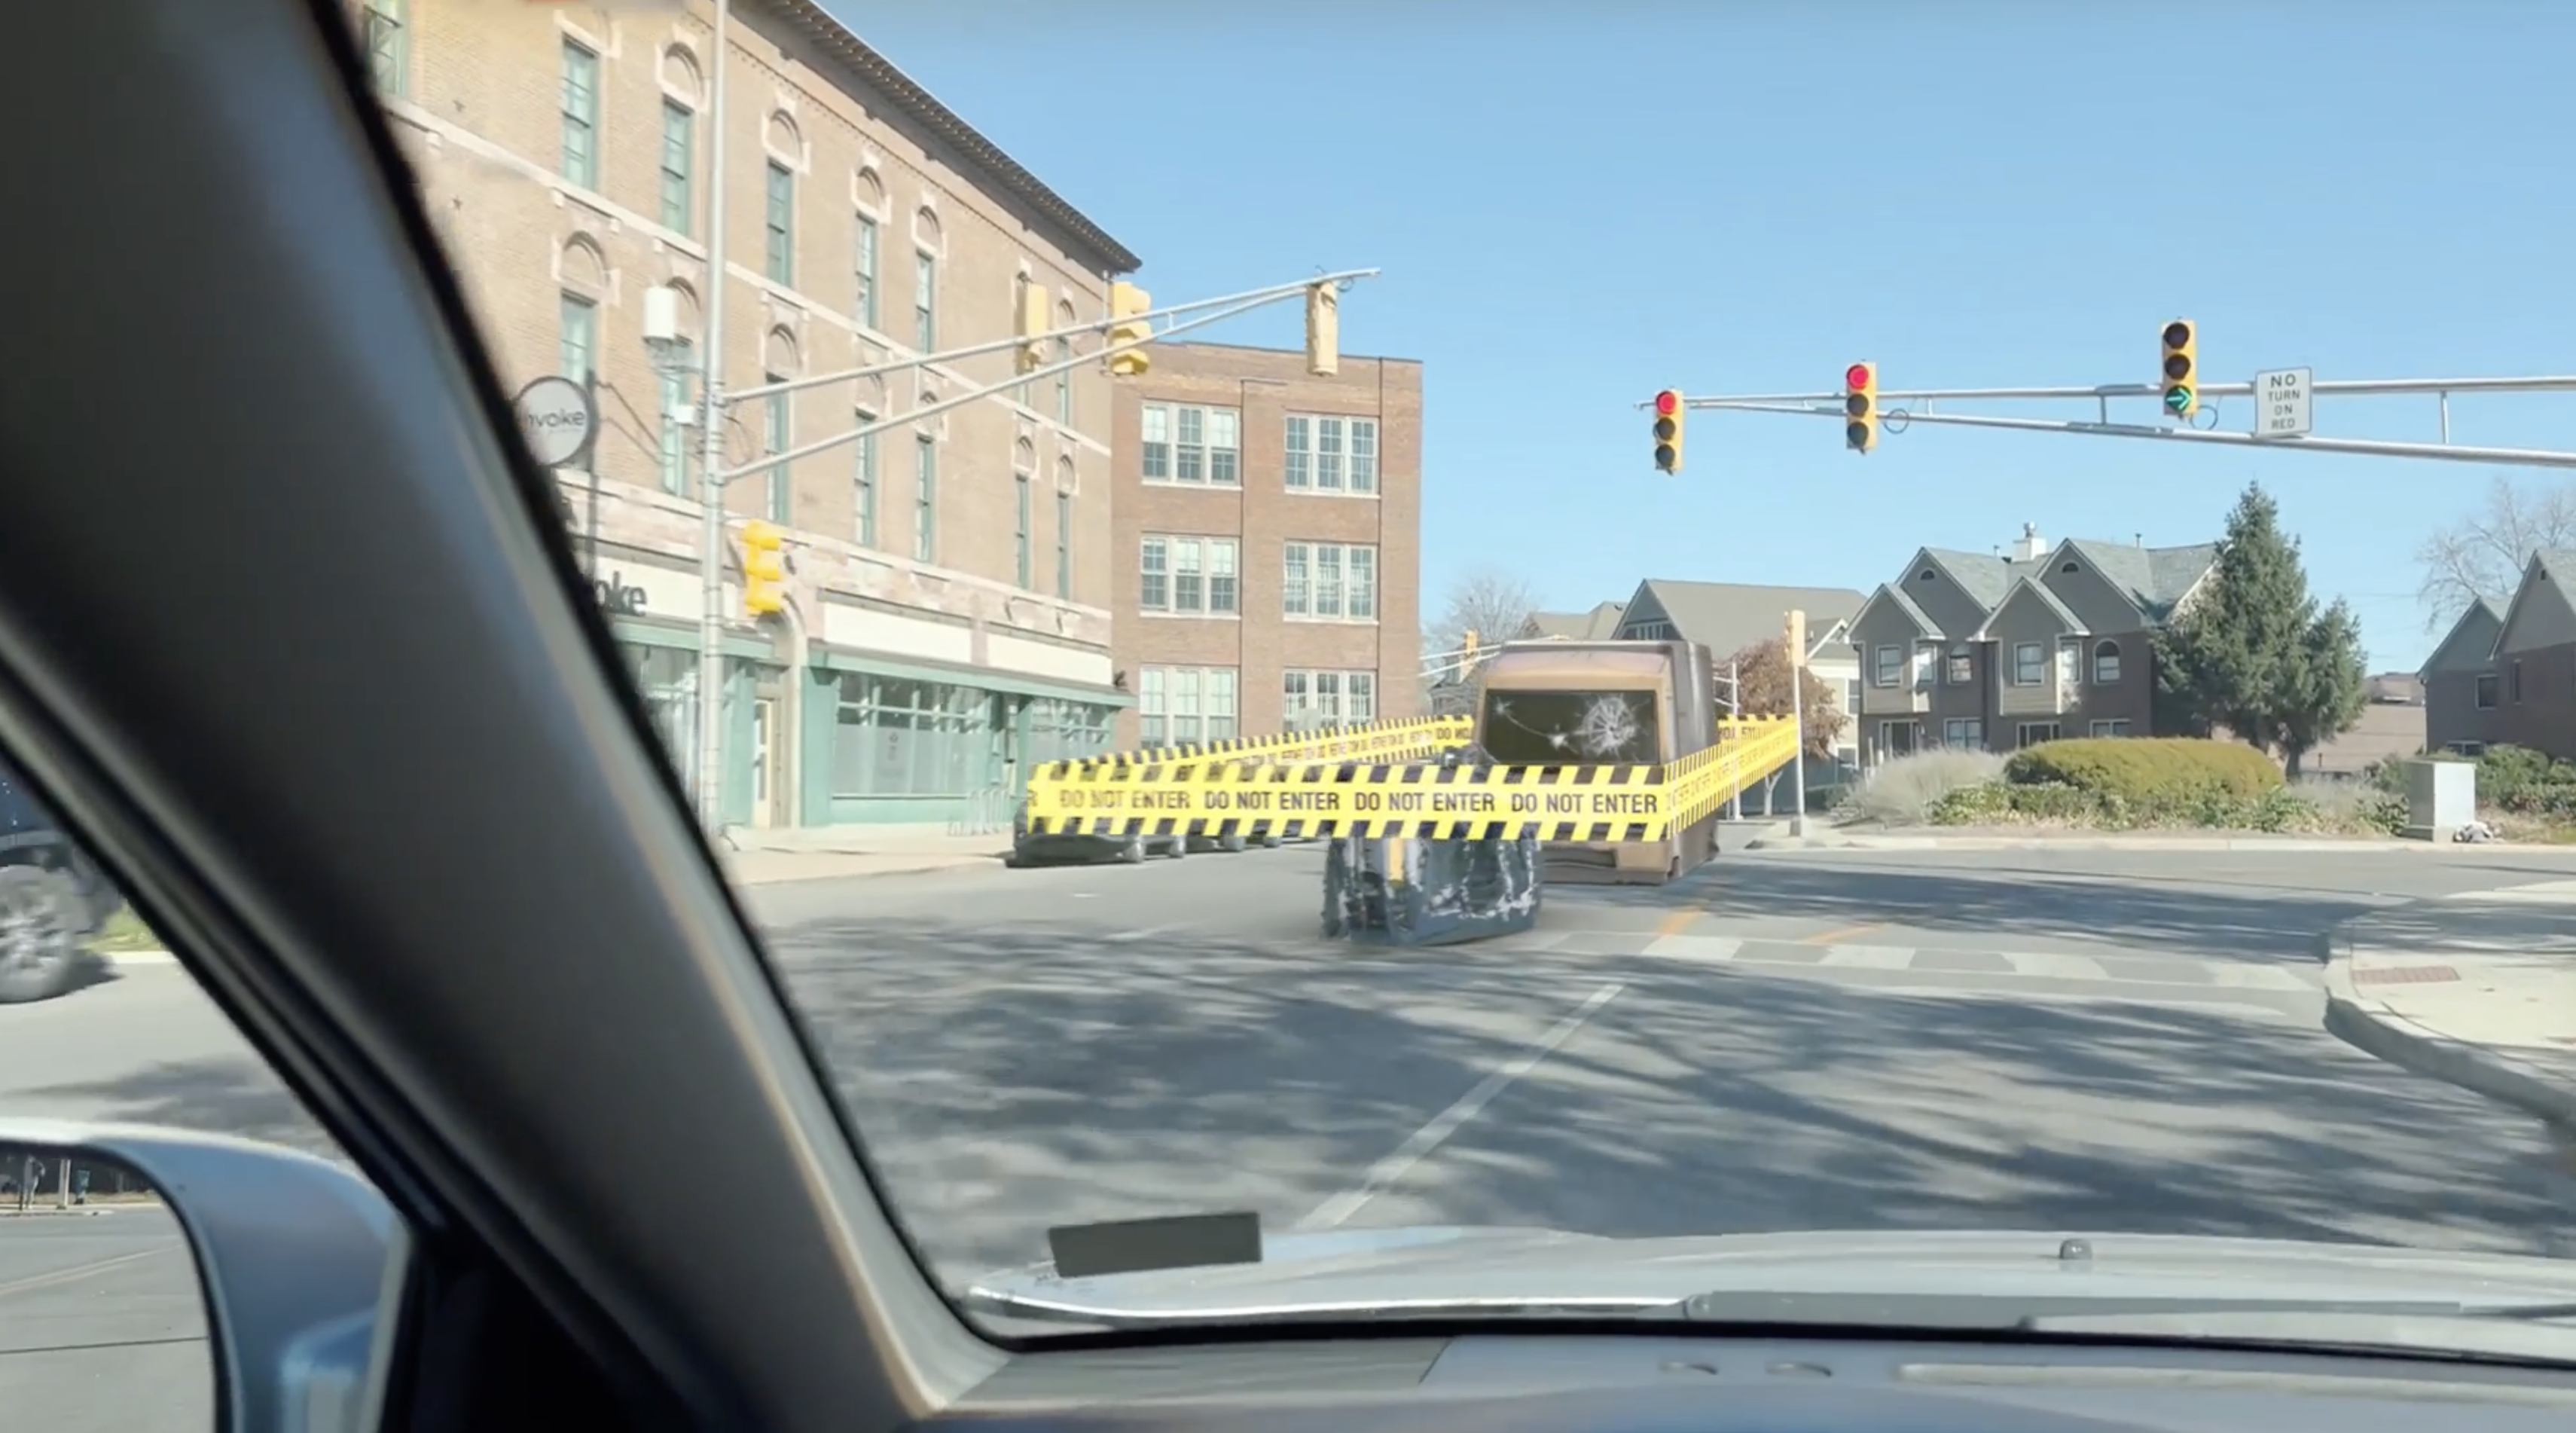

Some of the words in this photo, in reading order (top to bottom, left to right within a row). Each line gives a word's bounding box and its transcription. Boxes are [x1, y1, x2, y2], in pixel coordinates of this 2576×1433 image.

[2270, 373, 2296, 388] NO
[2267, 389, 2300, 402] TURN
[2274, 403, 2293, 416] ON
[2271, 417, 2296, 430] RED
[1060, 790, 1085, 808] DO
[1090, 790, 1125, 808] NOT
[1131, 790, 1190, 808] ENTER
[1205, 791, 1229, 809] DO
[1236, 791, 1271, 809] NOT
[1280, 792, 1339, 810] ENTER
[1355, 792, 1381, 811] DO
[1388, 793, 1424, 811] NOT
[1433, 793, 1495, 811] ENTER
[1511, 793, 1537, 812] DO
[1546, 793, 1584, 813] NOT
[1593, 793, 1658, 813] ENTER
